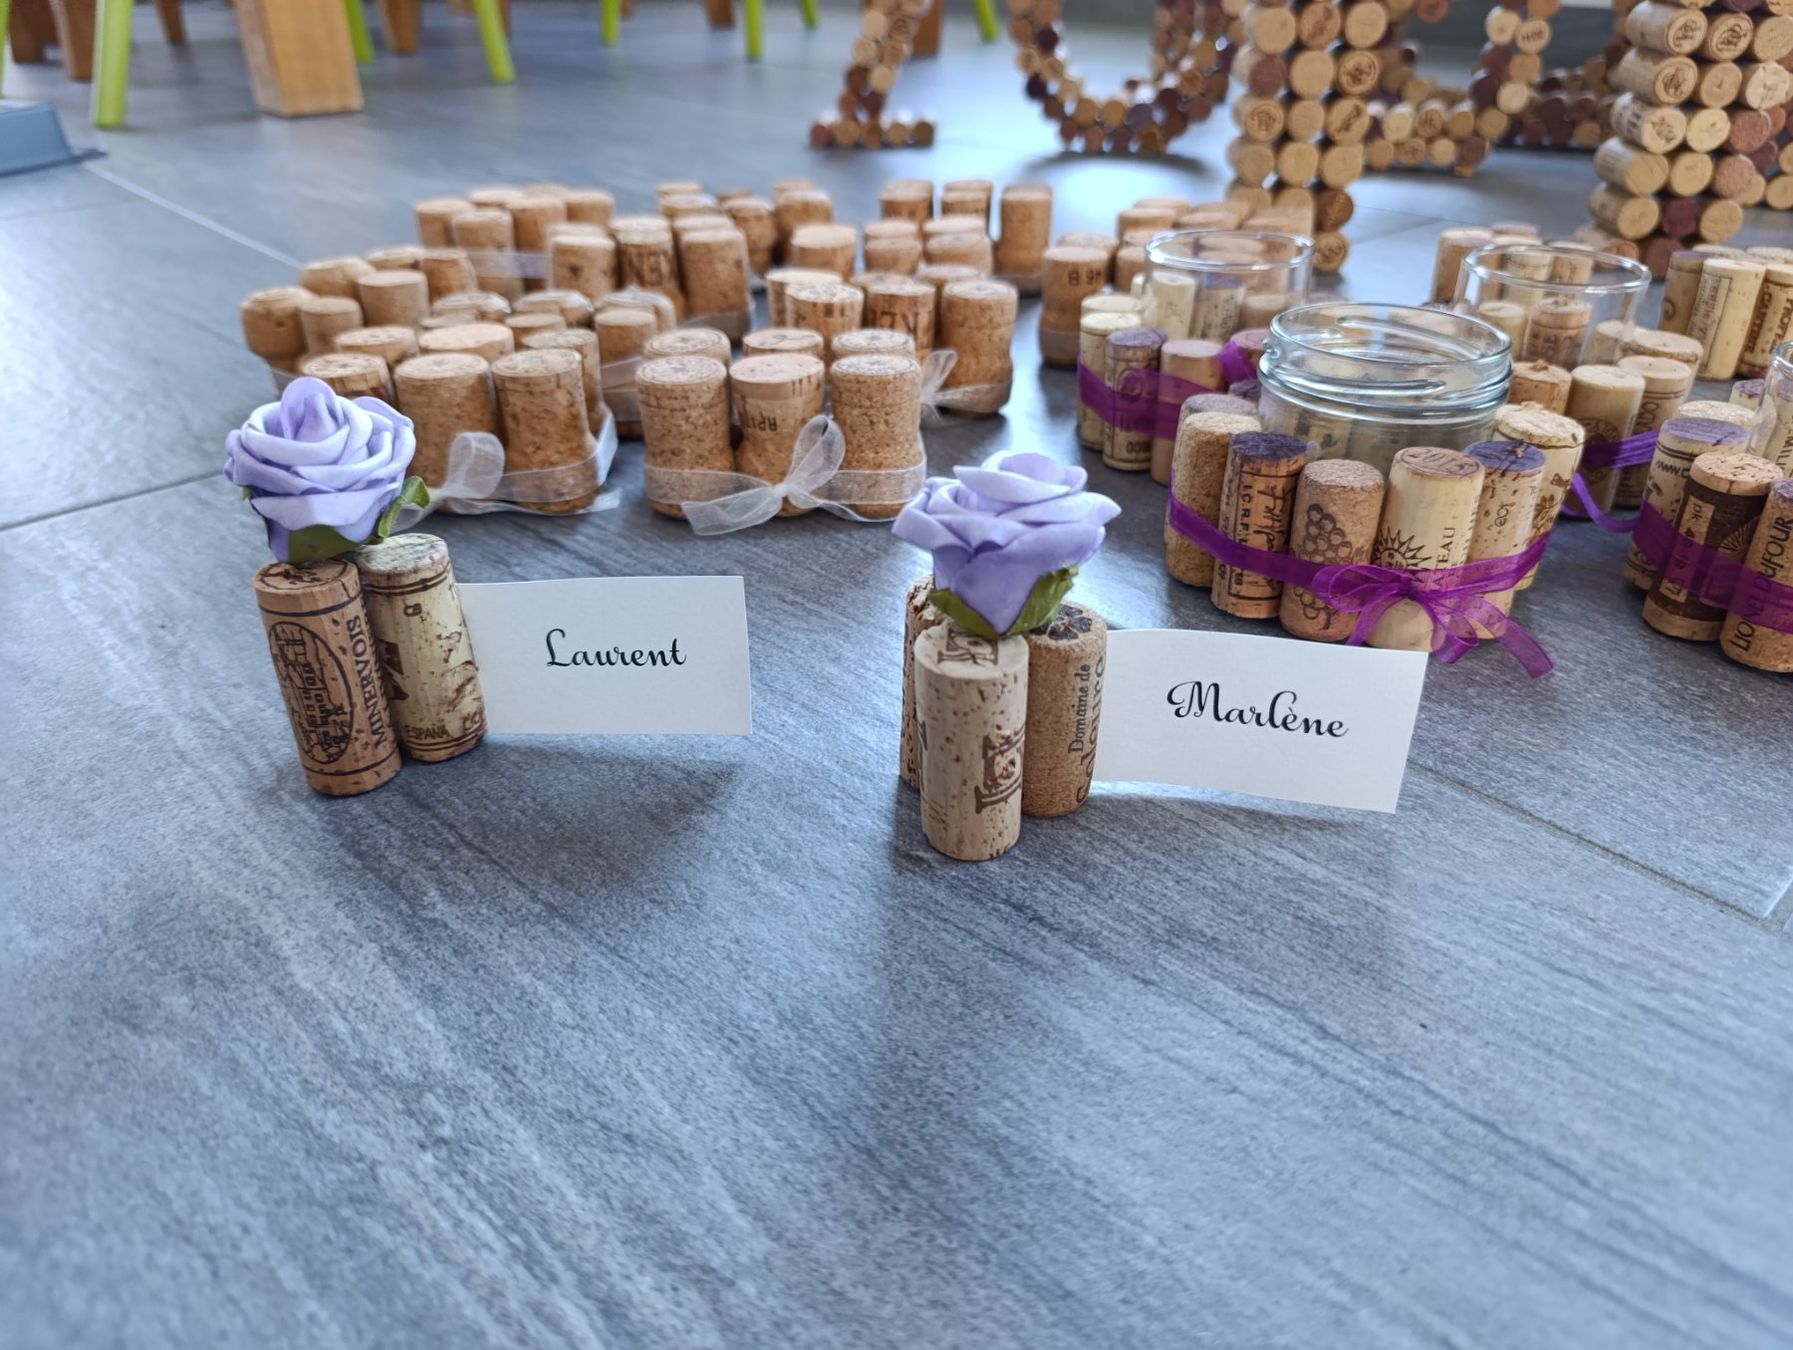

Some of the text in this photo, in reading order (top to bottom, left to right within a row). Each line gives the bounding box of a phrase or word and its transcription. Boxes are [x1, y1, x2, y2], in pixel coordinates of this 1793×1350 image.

[1753, 516, 1793, 594] DUFOUR
[346, 614, 387, 750] MINERVOIS
[546, 628, 687, 667] Laurent
[1068, 663, 1091, 754] Domaine de
[1167, 681, 1349, 737] Marlène
